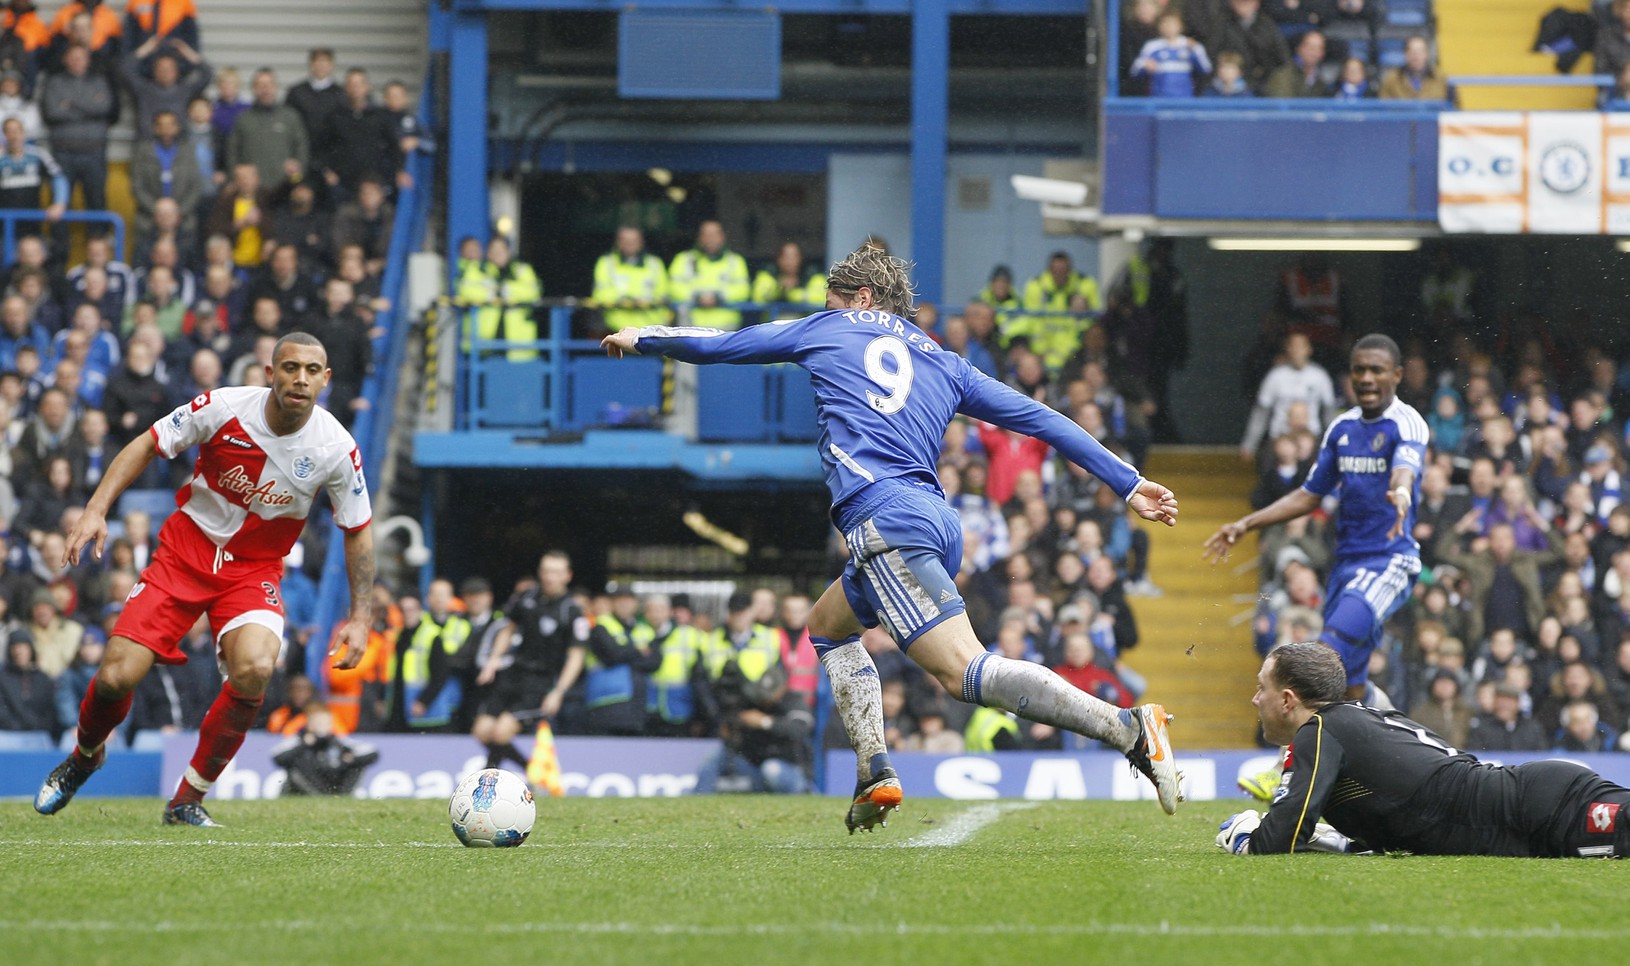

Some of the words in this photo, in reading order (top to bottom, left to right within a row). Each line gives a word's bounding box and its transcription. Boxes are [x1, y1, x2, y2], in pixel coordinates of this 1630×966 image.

[842, 310, 935, 353] TORRES
[863, 334, 914, 415] 9
[217, 464, 295, 506] AirAsia
[260, 581, 280, 607] 3
[1345, 567, 1379, 592] 21
